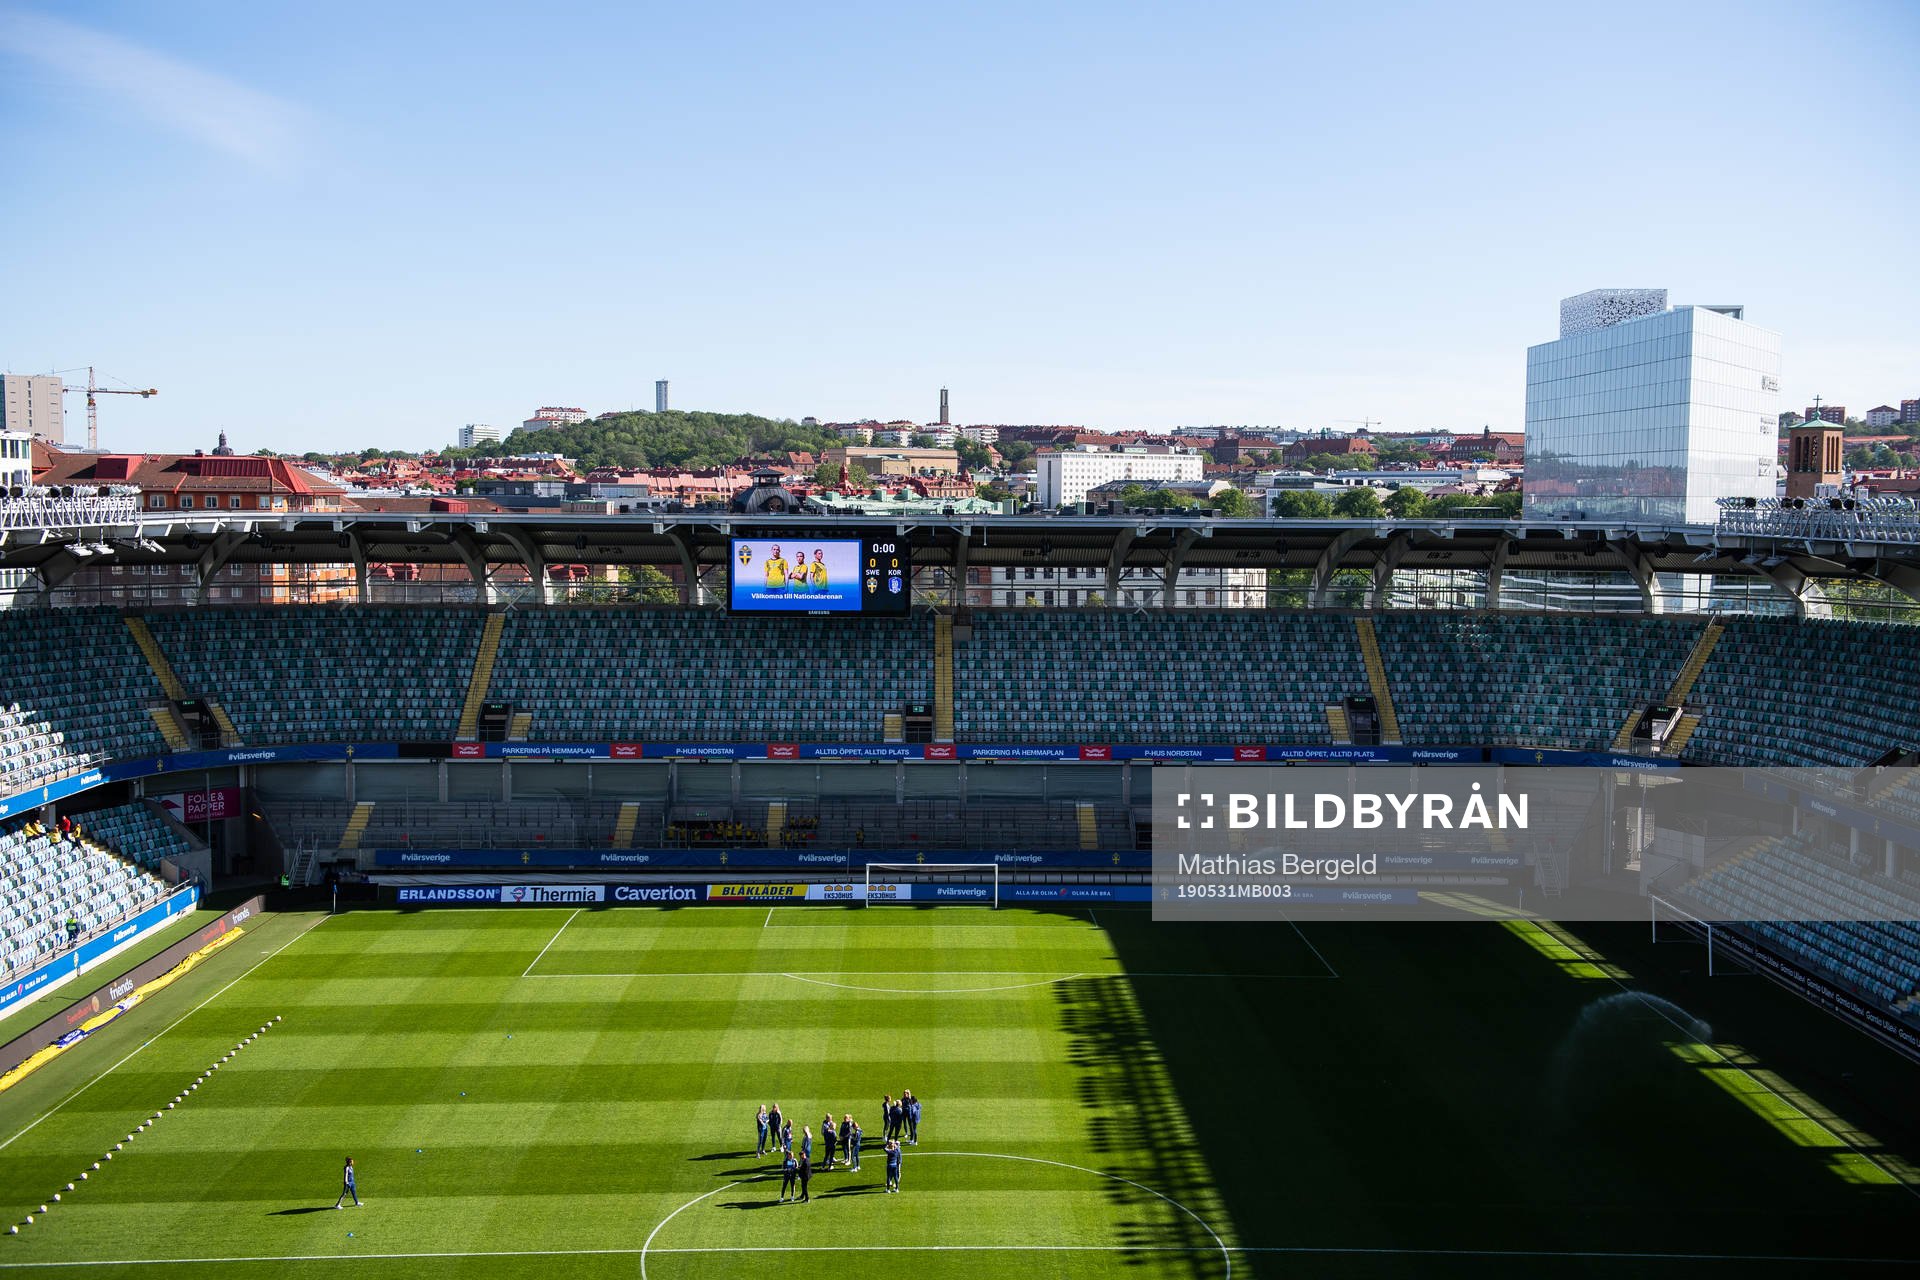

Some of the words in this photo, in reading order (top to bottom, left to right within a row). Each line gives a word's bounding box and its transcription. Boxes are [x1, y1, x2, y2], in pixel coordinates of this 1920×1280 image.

[872, 543, 895, 553] 0:00
[869, 558, 877, 568] 0
[891, 558, 899, 568] 0
[502, 747, 541, 755] PARKERING
[541, 746, 551, 755] PÅ
[551, 747, 595, 755] HEMMAPLAN
[814, 748, 838, 756] ALLTID
[863, 748, 888, 756] ALLTID
[888, 748, 910, 756] PLATS
[972, 748, 1011, 756] PARKERING
[1011, 747, 1021, 756] PÅ
[1021, 748, 1065, 756] HEMMAPLAN
[1281, 750, 1304, 758] ALLTID
[1330, 750, 1353, 758] ALLTID
[1353, 750, 1375, 758] PLATS
[1412, 750, 1459, 760] #viärsverige
[228, 751, 276, 761] #viärsverige
[401, 853, 451, 863] #viärsverige
[600, 853, 650, 863] #viärsverige
[798, 853, 847, 863] #viärsverige
[399, 889, 496, 900] ERLANDSSON
[530, 887, 596, 902] Thermia
[614, 886, 697, 901] Caverion
[722, 884, 794, 896] BLÅKLÄDER
[936, 887, 987, 897] #viärsverige
[232, 907, 250, 924] friends
[109, 977, 134, 1000] friends
